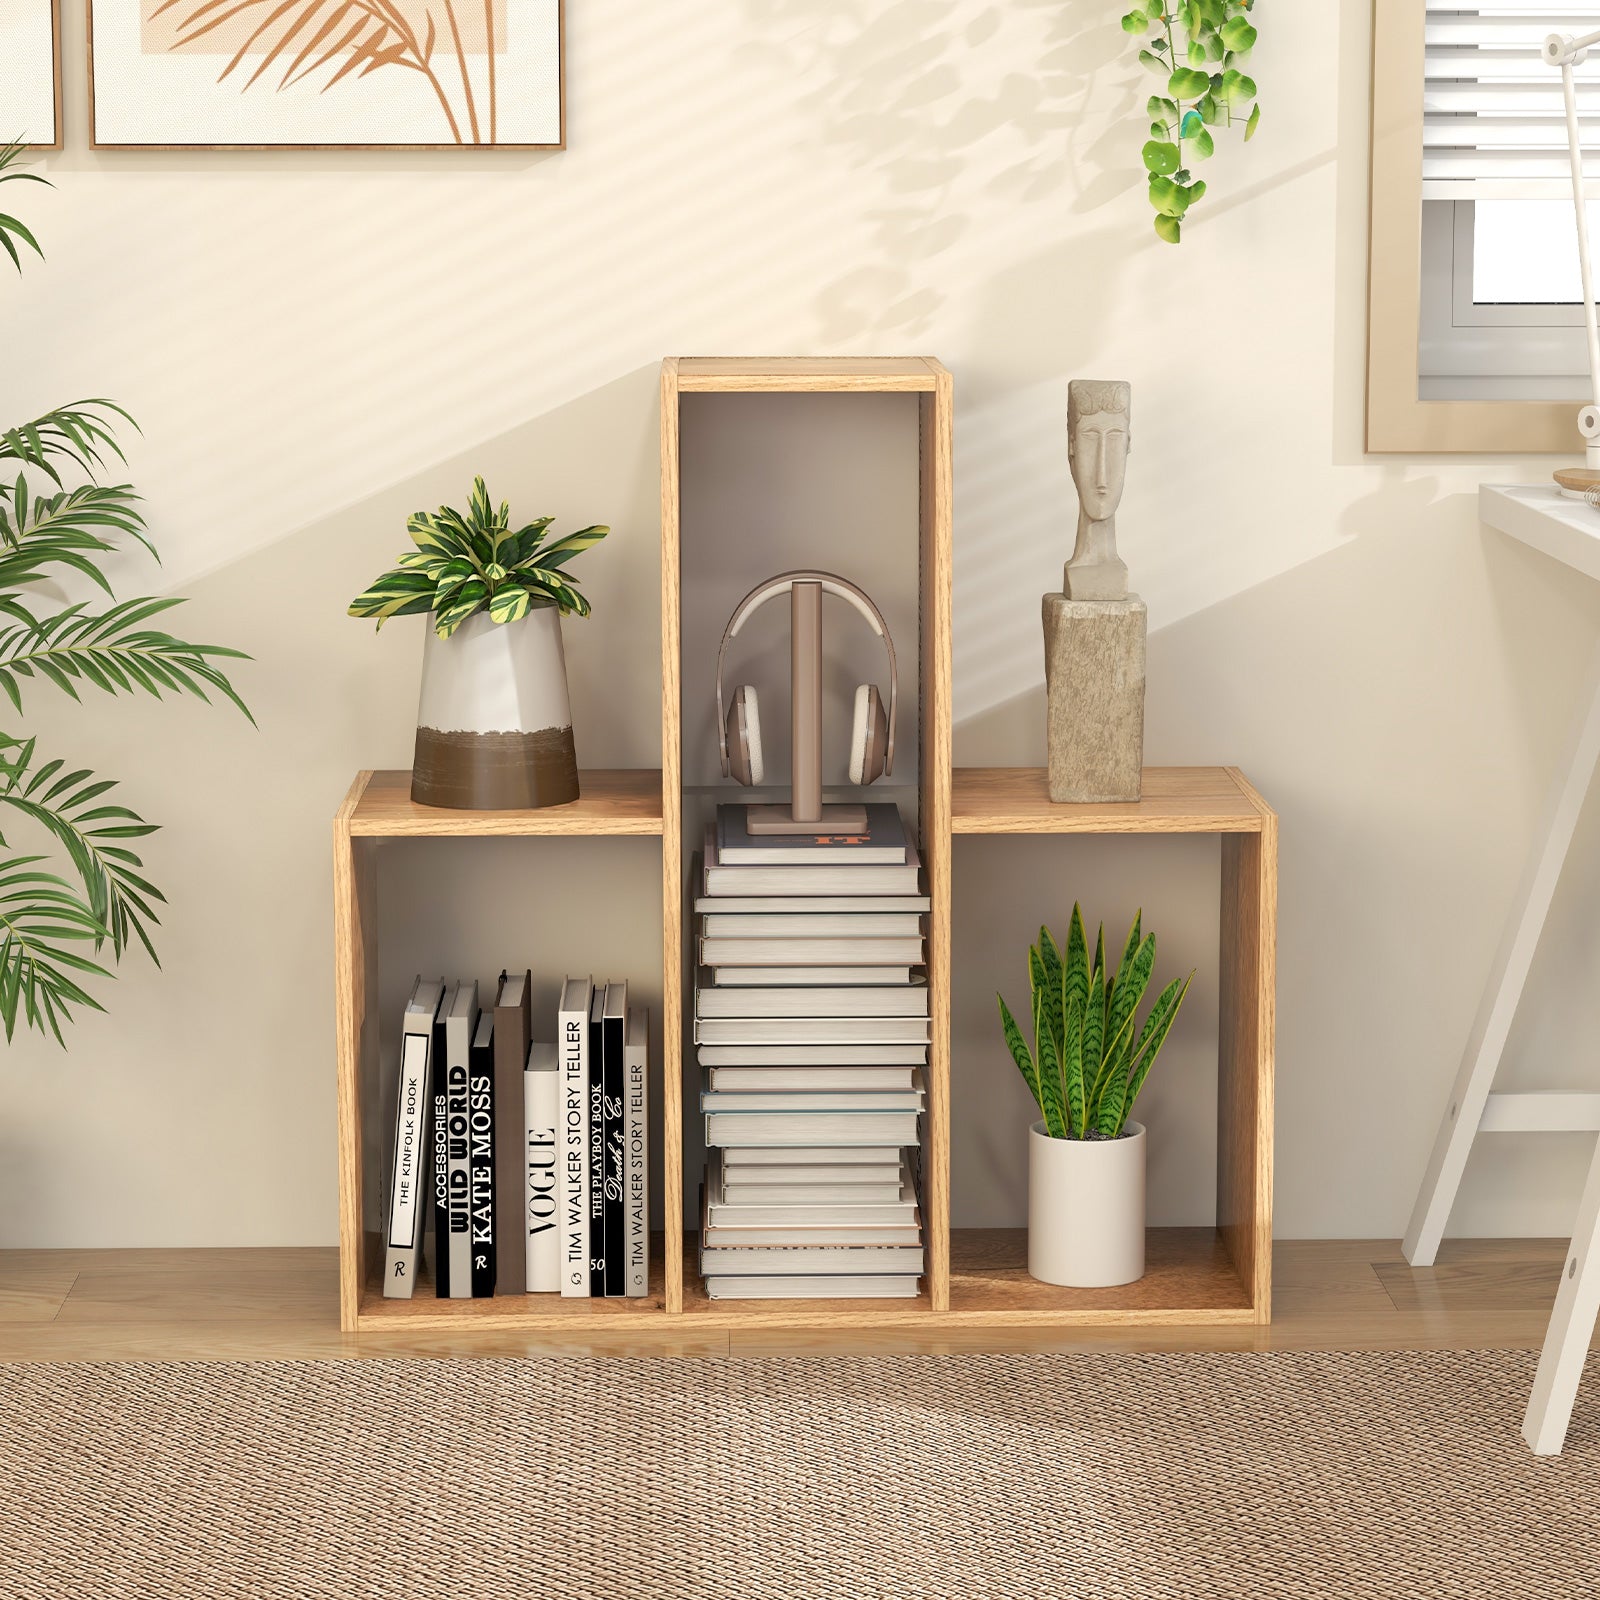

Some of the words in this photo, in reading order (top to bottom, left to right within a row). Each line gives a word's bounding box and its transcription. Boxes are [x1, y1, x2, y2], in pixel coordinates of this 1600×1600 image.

[567, 1021, 580, 1083] TELLER
[407, 1077, 417, 1115] BOOK
[449, 1065, 468, 1162] WORLD
[470, 1076, 491, 1158] MOSS
[567, 1090, 580, 1147] STORY
[592, 1083, 602, 1122] BOOK
[604, 1095, 622, 1120] Co
[631, 1064, 642, 1117] TELLER
[402, 1120, 414, 1176] KINFOLK
[436, 1094, 446, 1209] ACCESSORIES
[592, 1125, 602, 1188] PLAYBOY
[604, 1142, 624, 1202] Death
[631, 1121, 643, 1171] STORY
[400, 1180, 410, 1206] THE
[450, 1168, 469, 1233] WILD
[472, 1165, 492, 1245] KATE
[528, 1128, 556, 1238] VOGUE
[568, 1151, 581, 1226] WALKER
[592, 1191, 602, 1219] THE
[631, 1174, 642, 1238] WALKER
[568, 1233, 581, 1263] TIM
[590, 1259, 605, 1271] 50
[632, 1241, 643, 1267] TIM
